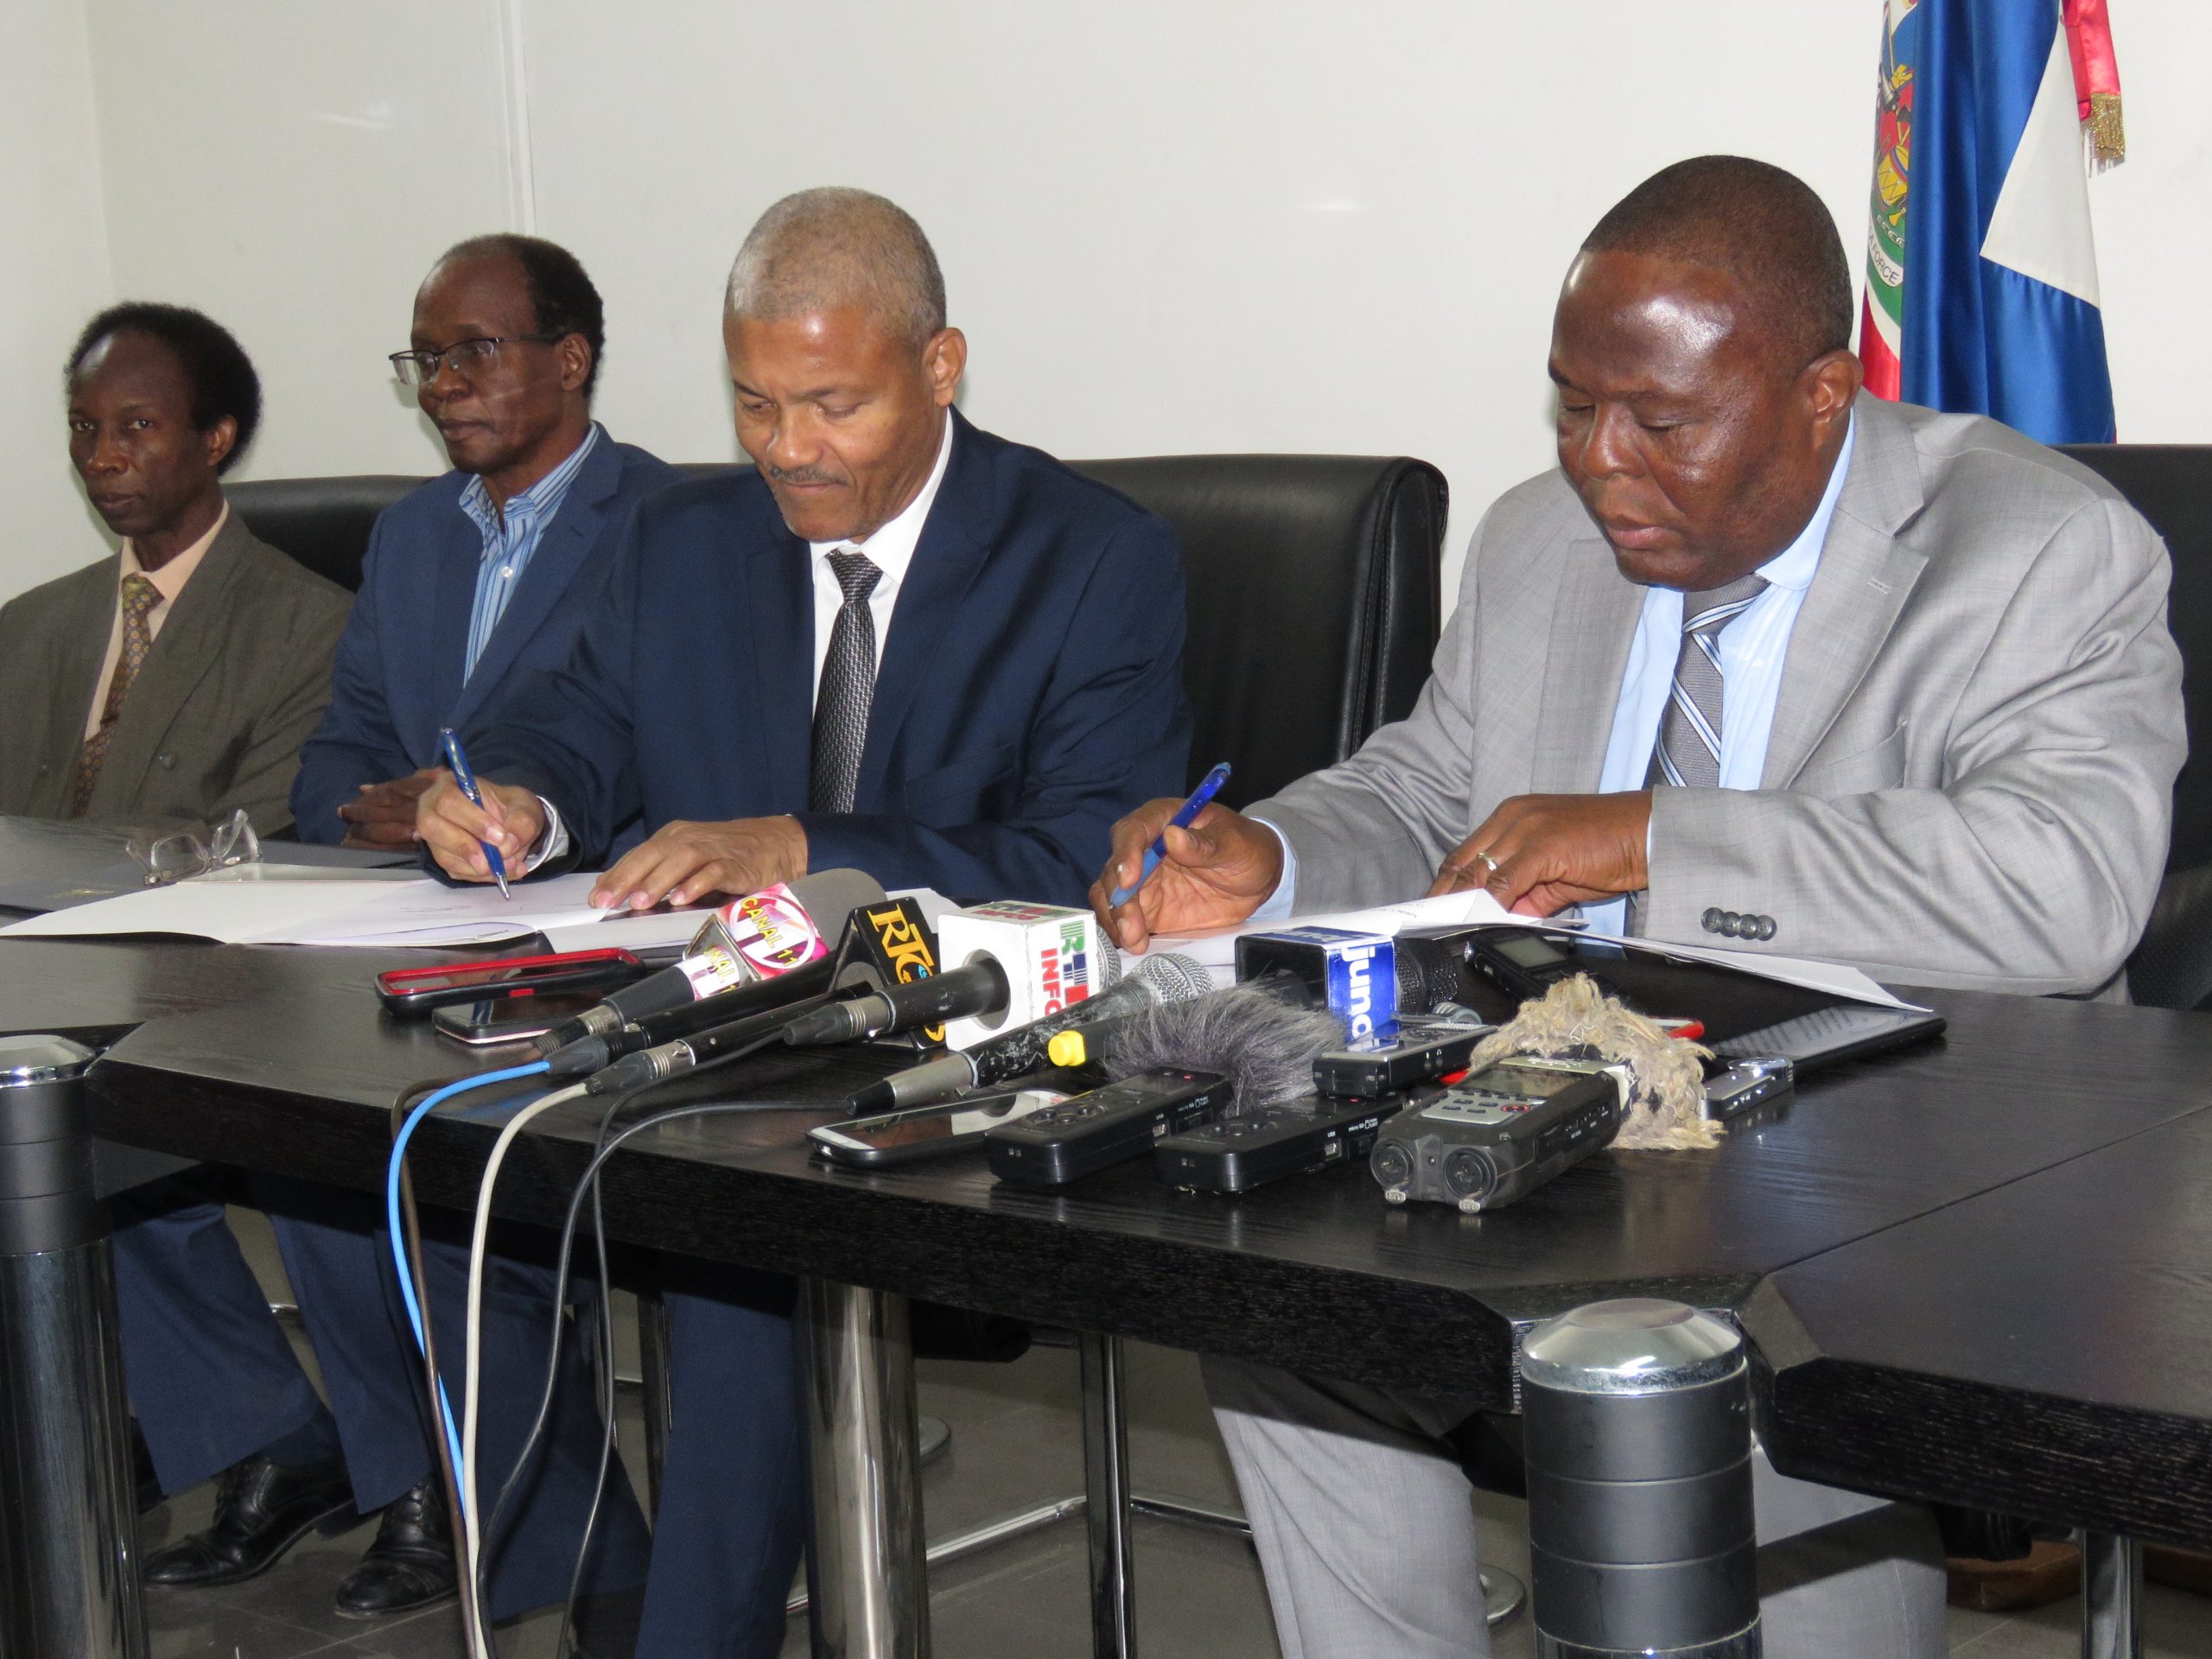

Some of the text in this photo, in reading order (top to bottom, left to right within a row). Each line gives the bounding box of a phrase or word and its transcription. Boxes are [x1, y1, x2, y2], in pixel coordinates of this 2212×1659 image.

[1871, 244, 1900, 285] FORCE
[741, 897, 799, 967] CANAL 11
